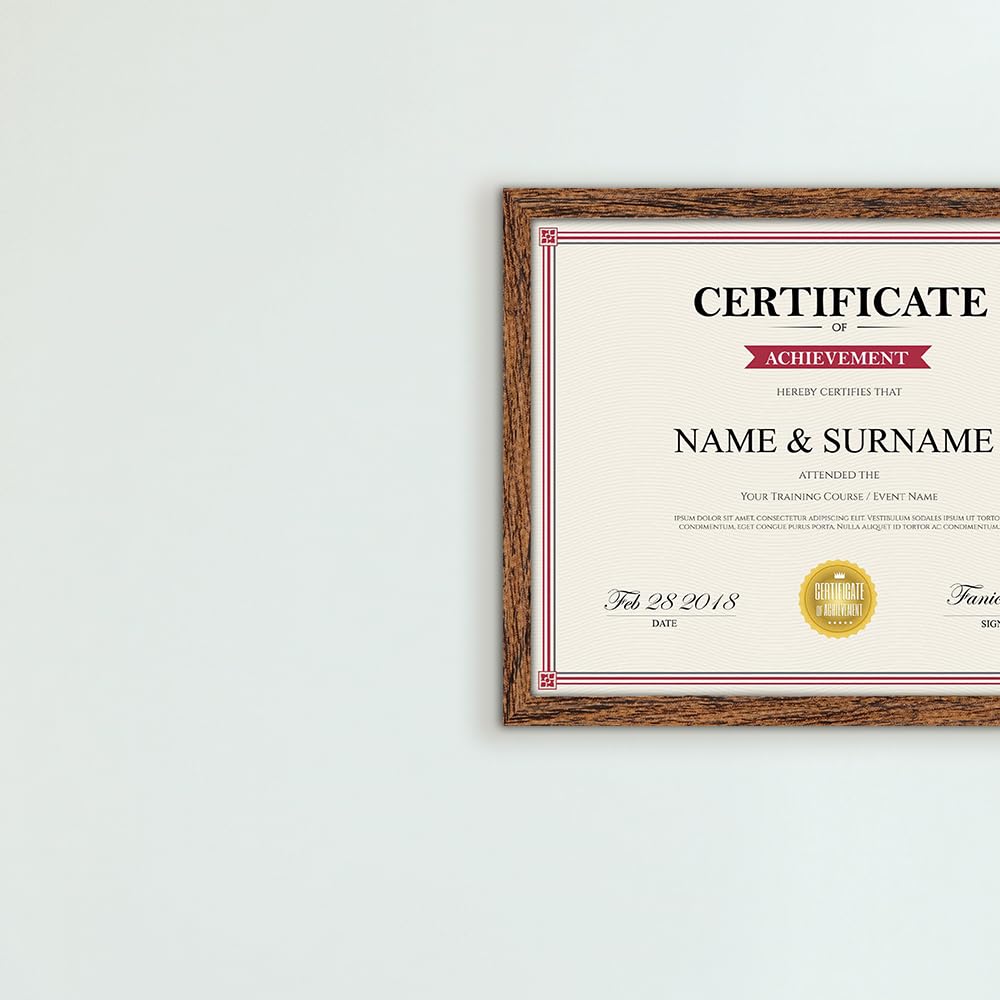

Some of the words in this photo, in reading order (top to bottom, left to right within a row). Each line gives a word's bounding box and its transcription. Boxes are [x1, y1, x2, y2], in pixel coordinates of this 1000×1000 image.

[693, 286, 988, 317] CERTIFICATE
[831, 322, 848, 332] OF
[765, 351, 909, 366] ACHIEVEMENT
[776, 387, 817, 397] HEREBY
[819, 387, 872, 397] CERTIFIES
[874, 387, 903, 397] THAT
[674, 428, 777, 454] NAME
[786, 428, 813, 454] &
[823, 427, 994, 454] SURNAME
[798, 470, 857, 480] ATTENDED
[858, 470, 880, 480] THE
[740, 491, 768, 501] YOUR
[770, 491, 822, 501] TRAINING
[823, 491, 864, 501] COURSE
[865, 491, 872, 501] /
[873, 491, 906, 501] EVENT
[908, 491, 938, 501] NAME
[673, 514, 696, 522] IPSUM
[696, 514, 722, 522] DOLOR
[722, 514, 733, 522] SIT
[755, 514, 807, 522] CONSECTETUR
[808, 514, 850, 522] ADIPISCING
[867, 514, 911, 522] VESTIBULUM
[911, 514, 942, 522] SODALES
[943, 514, 965, 522] IPSUM
[965, 514, 975, 522] UT
[861, 523, 891, 532] ALIQUET
[814, 582, 865, 601] CERTIFICATE
[603, 588, 641, 611] Feb
[645, 592, 678, 611] 28
[679, 592, 740, 611] 2018
[823, 603, 863, 617] ACHIEVEMENT
[652, 619, 678, 628] DATE
